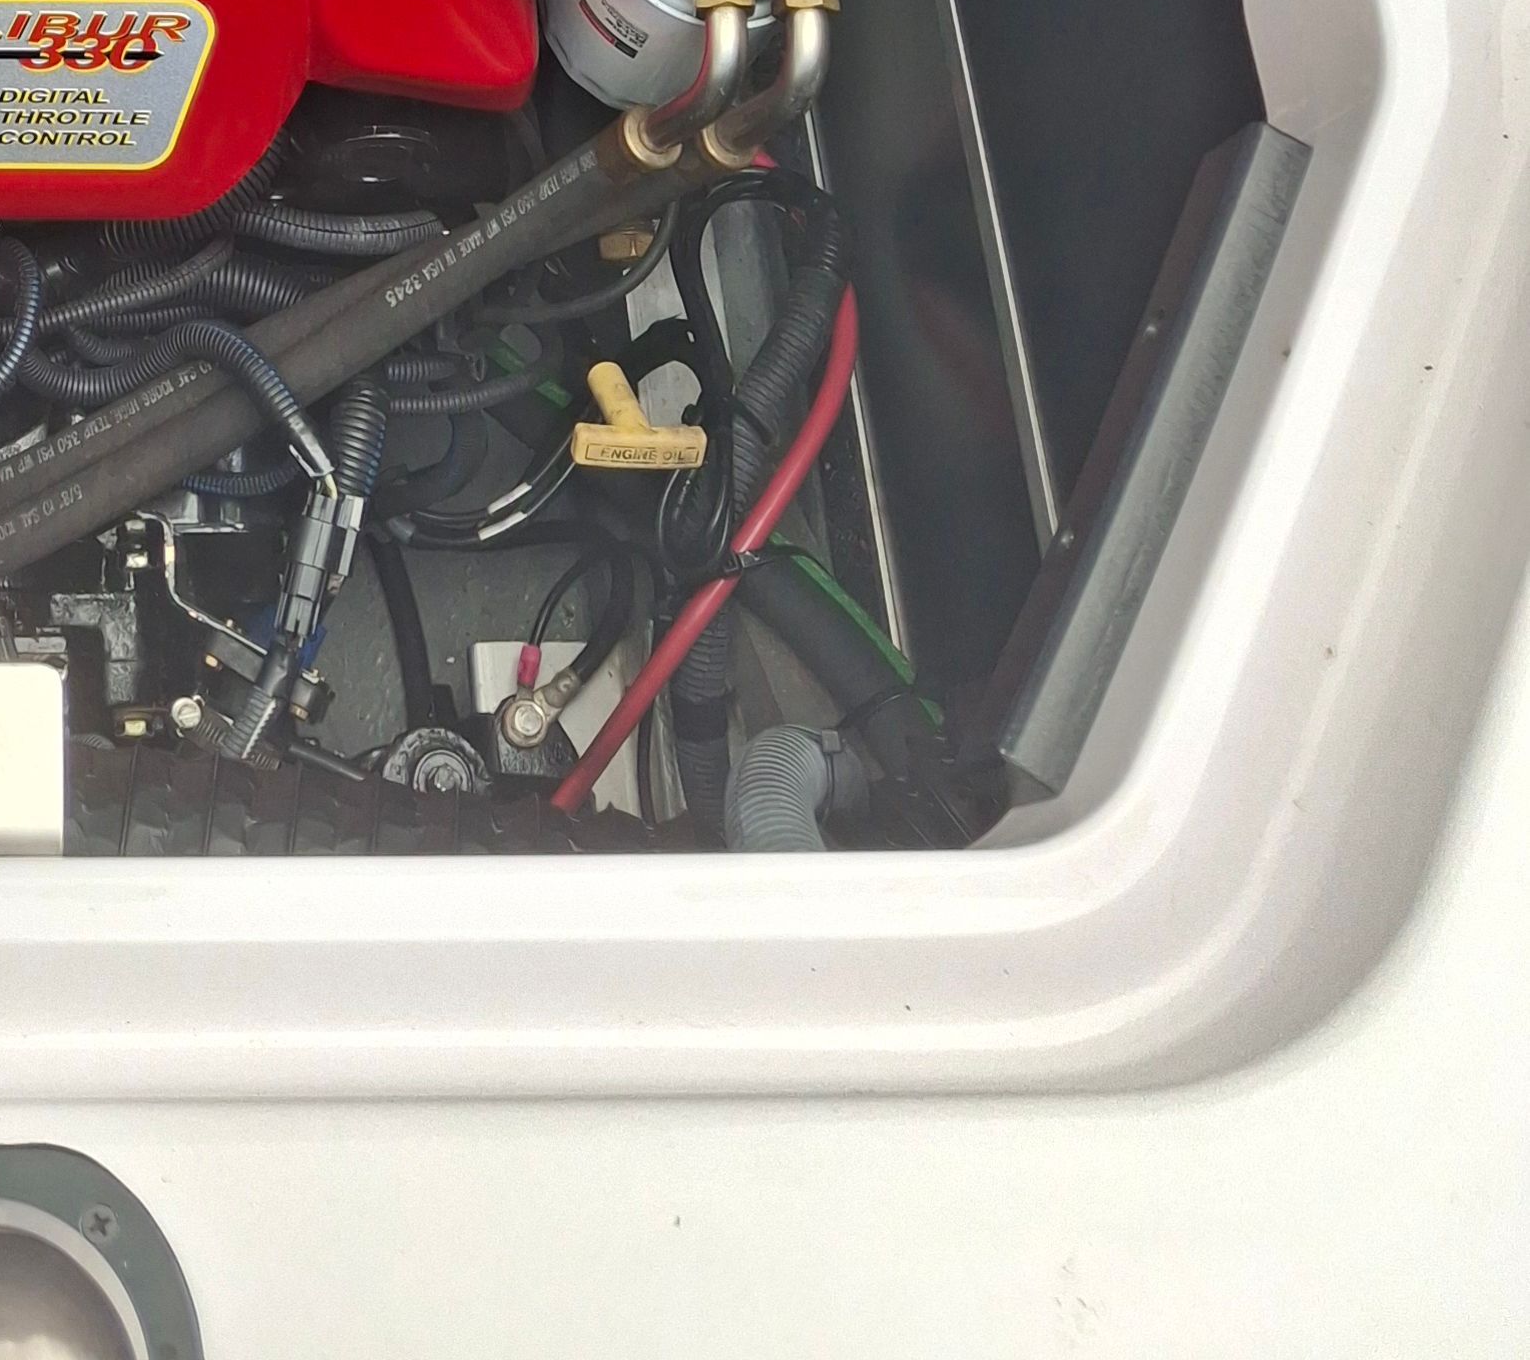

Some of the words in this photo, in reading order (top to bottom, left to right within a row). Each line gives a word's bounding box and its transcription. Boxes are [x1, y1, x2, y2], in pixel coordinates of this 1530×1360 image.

[18, 32, 160, 73] 330
[83, 416, 110, 440] TEMP
[36, 444, 55, 464] PSI
[57, 431, 80, 454] 350
[600, 446, 657, 460] ENGINE
[663, 448, 685, 460] OIL
